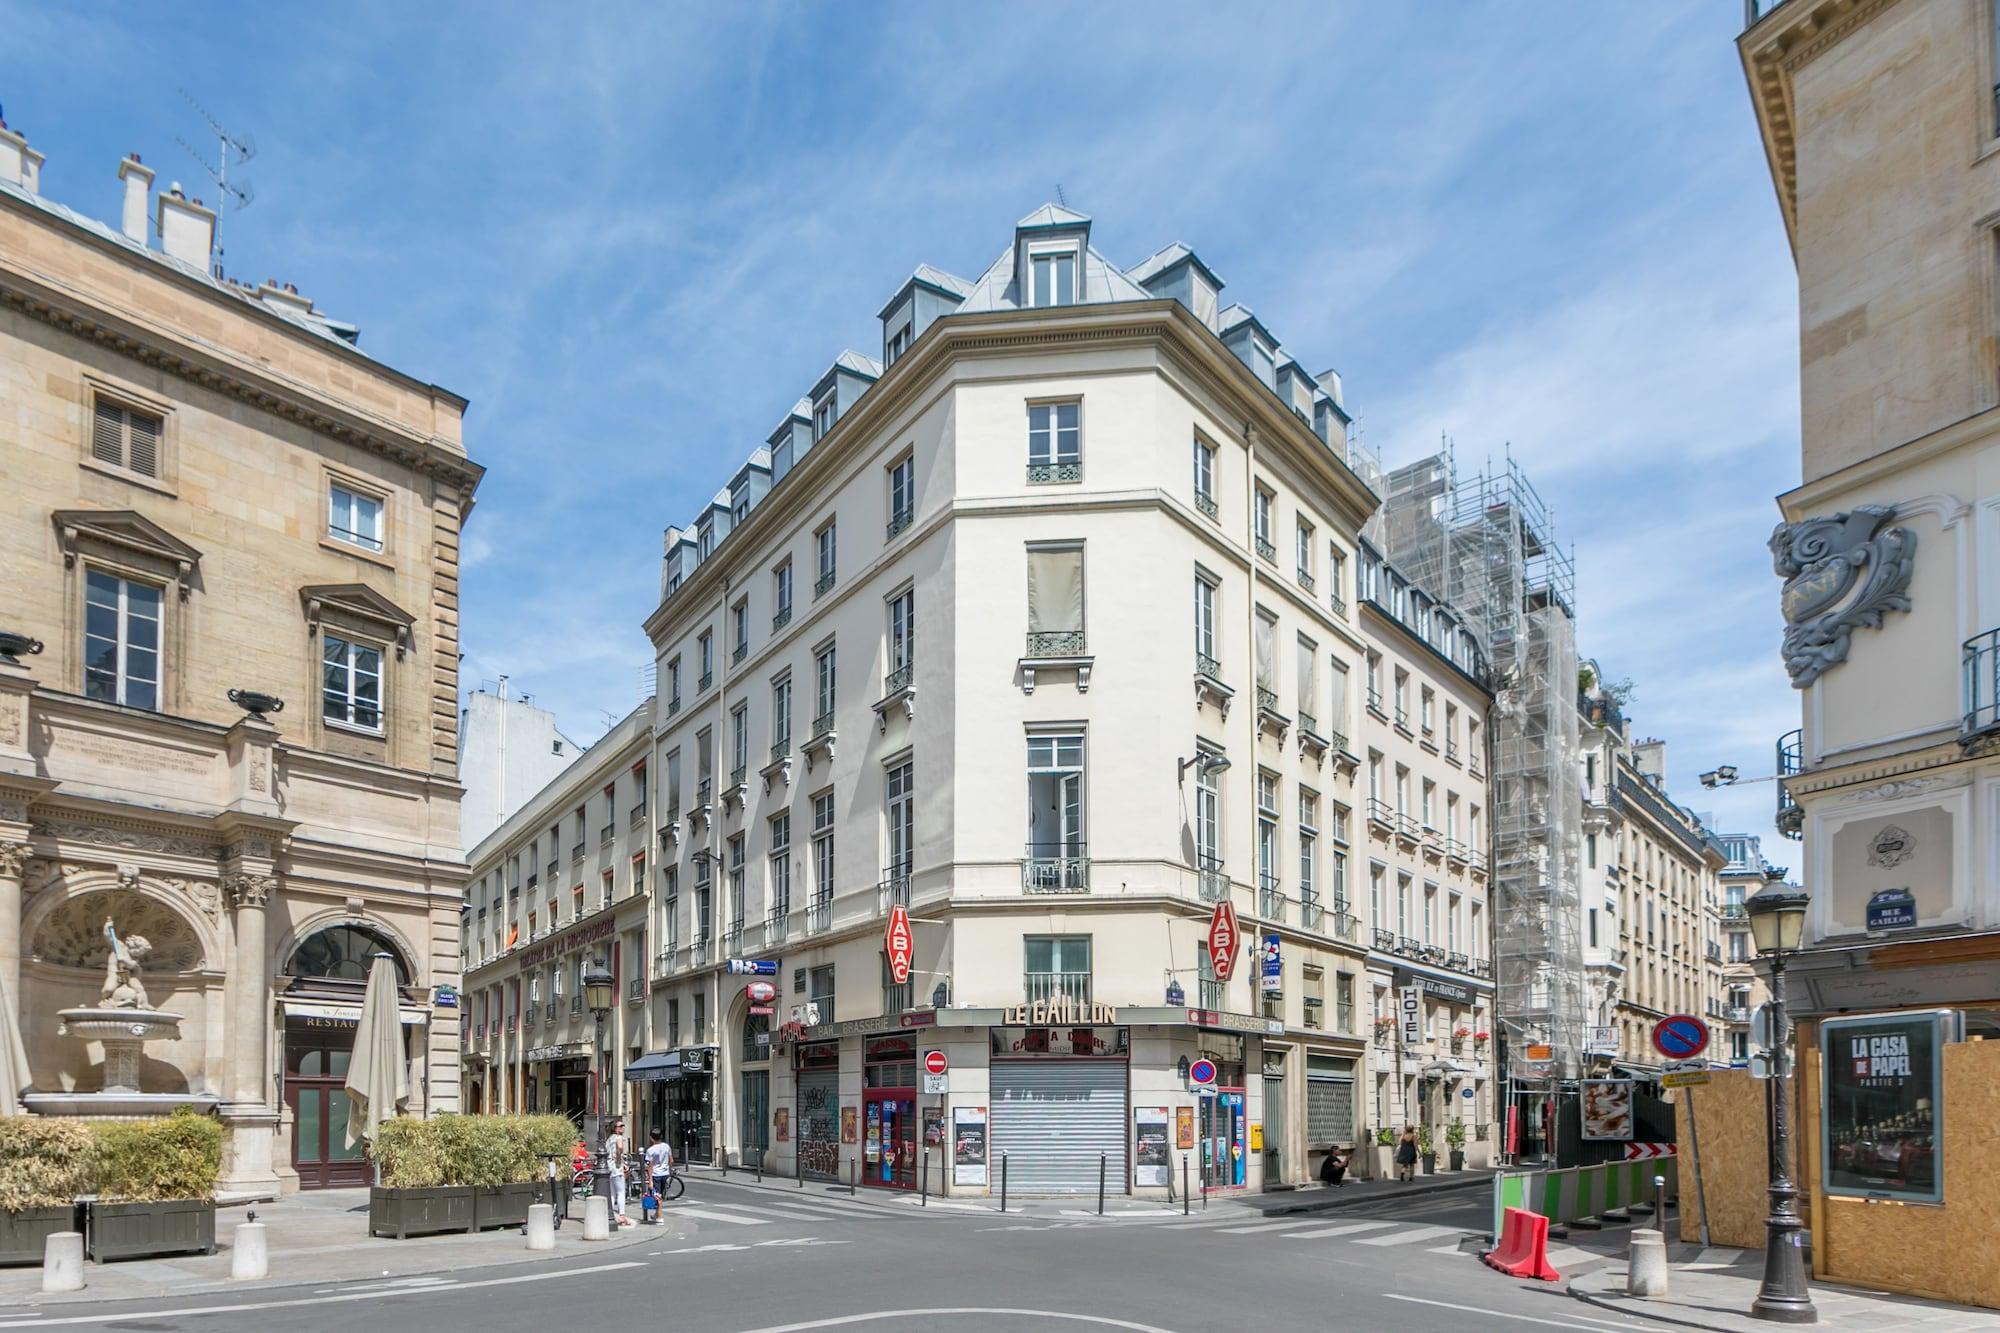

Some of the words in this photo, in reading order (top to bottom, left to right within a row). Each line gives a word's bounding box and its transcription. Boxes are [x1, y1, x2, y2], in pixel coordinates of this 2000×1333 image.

[1870, 915, 1912, 926] GAILLON
[1881, 908, 1901, 916] RUE
[892, 907, 909, 979] TABAC
[1213, 902, 1231, 977] TABAC
[1004, 1004, 1027, 1024] LE
[1032, 994, 1116, 1024] GAILLON
[1403, 988, 1418, 1043] HOTEL
[306, 1017, 355, 1029] RESTAU
[817, 1024, 834, 1037] BAR
[842, 1017, 889, 1034] BRASSERIE
[1223, 1014, 1266, 1031] BRASSERIE
[1851, 1038, 1869, 1058] LA
[1870, 1036, 1909, 1057] CASA
[1856, 1061, 1867, 1074] DE
[1871, 1056, 1912, 1077] PAPEL
[1860, 1078, 1892, 1087] PARTIE
